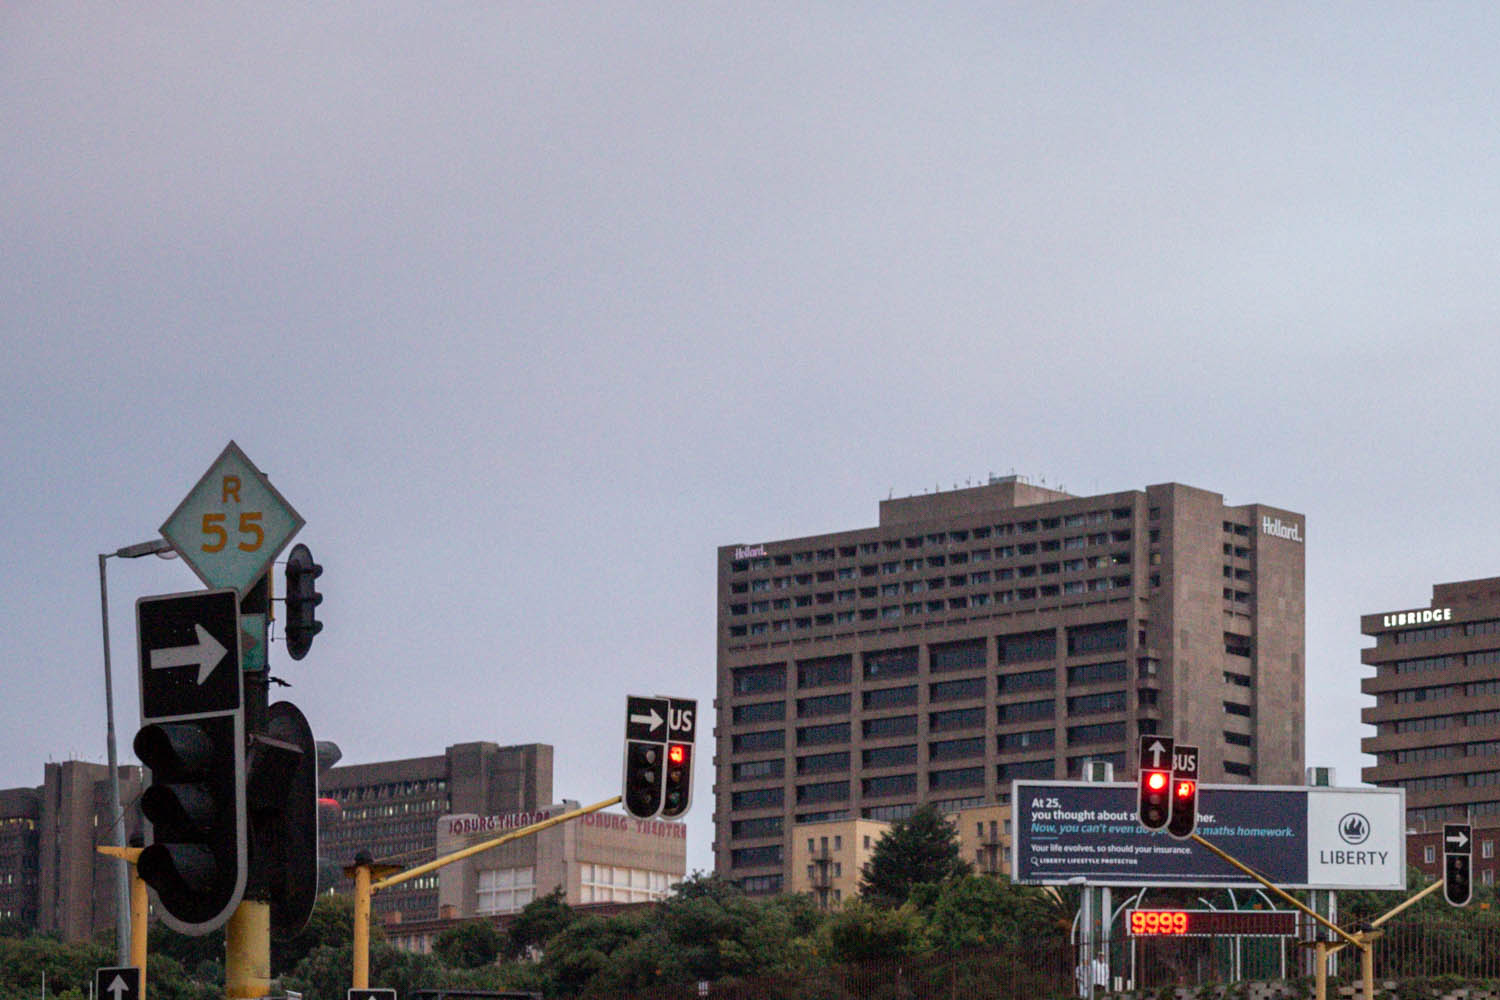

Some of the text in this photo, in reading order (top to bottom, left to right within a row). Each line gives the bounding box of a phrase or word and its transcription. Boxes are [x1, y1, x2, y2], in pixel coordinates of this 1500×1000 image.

[222, 475, 241, 504] R
[201, 512, 265, 553] 55
[1384, 608, 1451, 627] LIBRIDGE
[669, 709, 692, 732] US
[1032, 798, 1062, 809] At 25,
[449, 814, 495, 834] JOBURG
[1032, 811, 1051, 822] you
[1053, 810, 1095, 822] thought
[1097, 811, 1128, 821] about
[1031, 823, 1056, 834] Now,
[1059, 824, 1079, 835] you
[1081, 824, 1107, 833] can't
[1109, 825, 1133, 833] even
[1203, 825, 1235, 836] maths
[1237, 825, 1295, 837] homework.
[1031, 843, 1048, 852] Your
[1050, 843, 1062, 852] life
[1097, 845, 1106, 853] so
[1108, 844, 1133, 853] should
[1135, 846, 1152, 854] your
[1153, 845, 1193, 854] insurance.
[1320, 850, 1388, 865] LIBERTY
[1132, 912, 1187, 934] 9999
